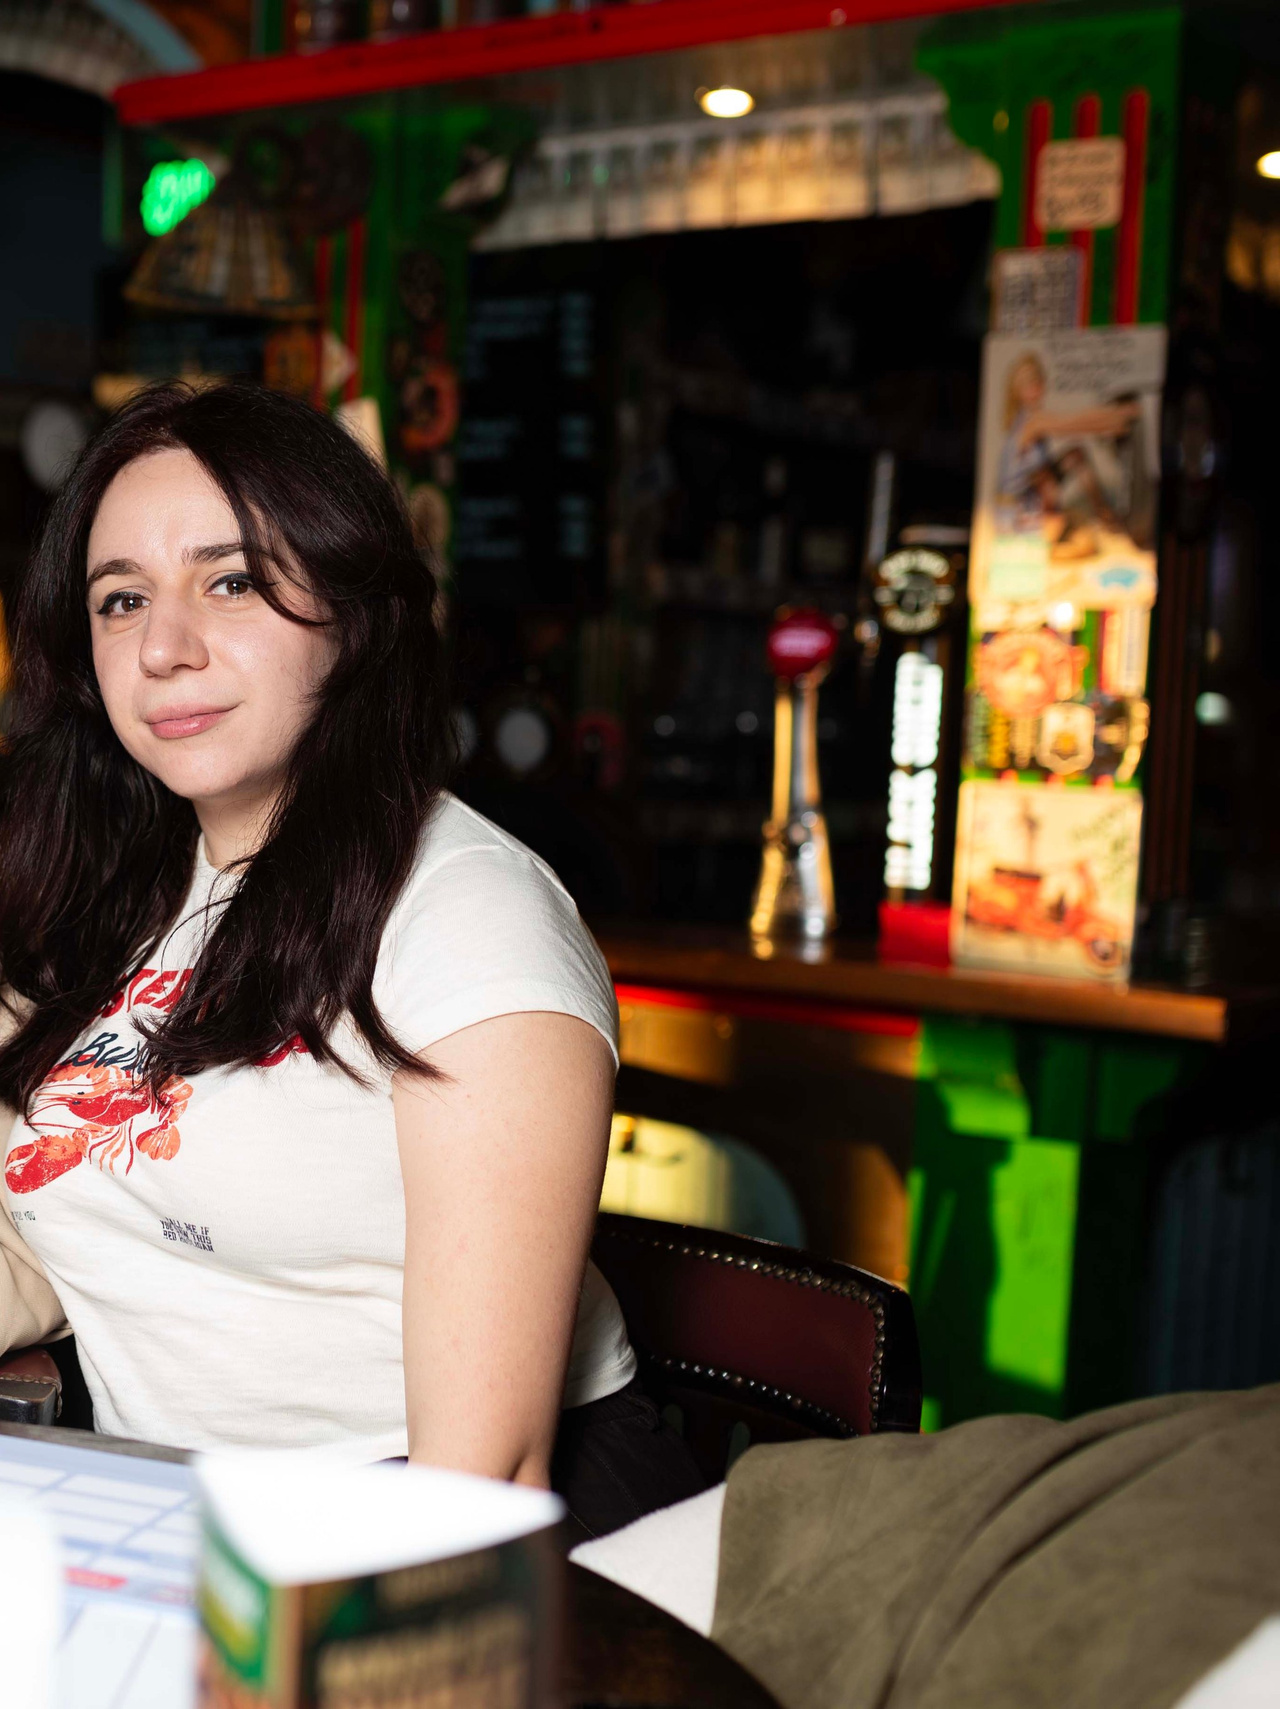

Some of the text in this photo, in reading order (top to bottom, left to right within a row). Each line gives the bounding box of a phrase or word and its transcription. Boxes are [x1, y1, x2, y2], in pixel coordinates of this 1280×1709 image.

[163, 1229, 177, 1242] RED
[183, 1222, 198, 1235] ME
[200, 1226, 210, 1236] IF
[190, 1232, 212, 1245] THIS
